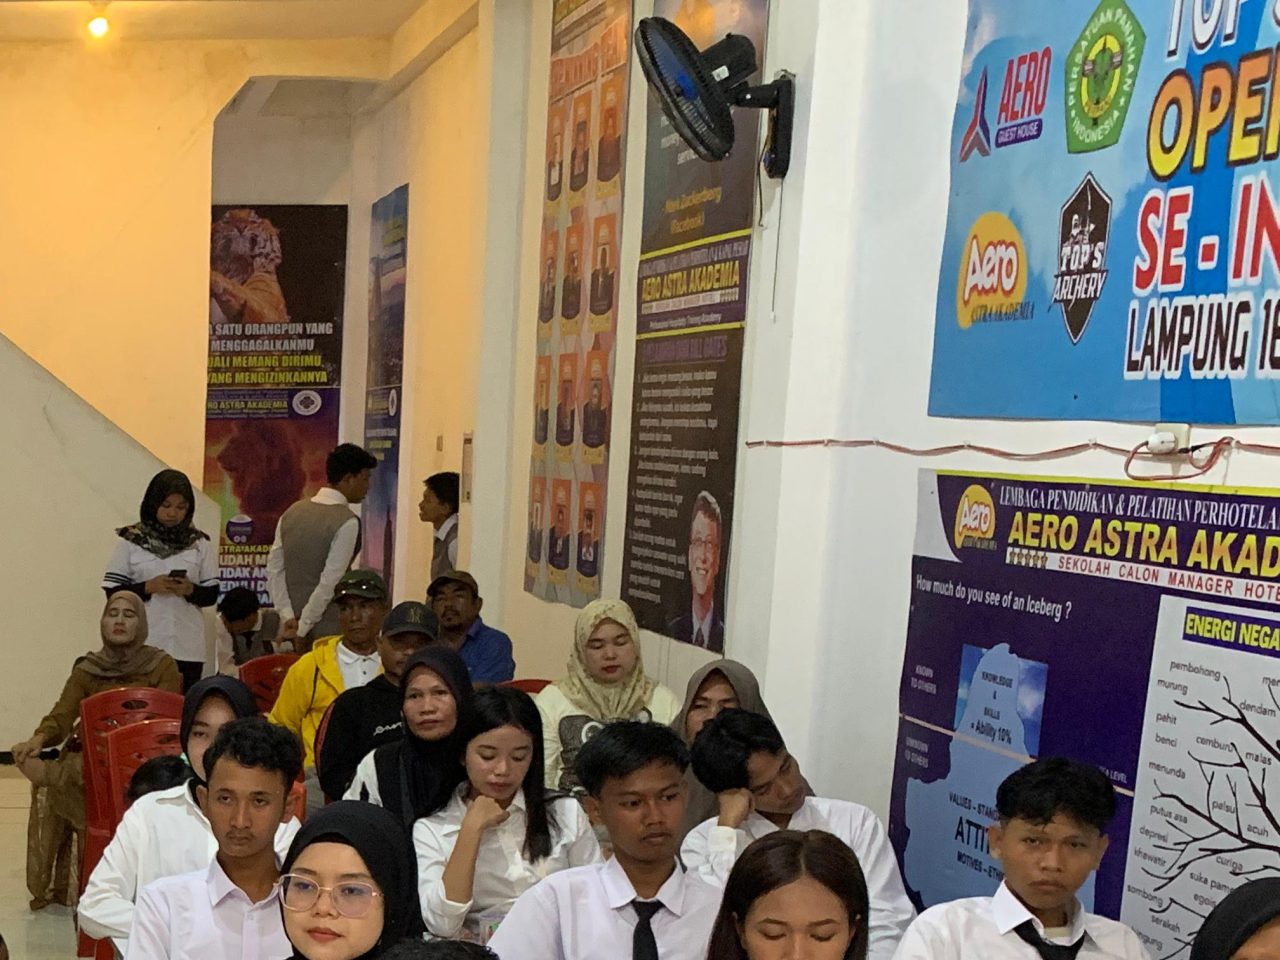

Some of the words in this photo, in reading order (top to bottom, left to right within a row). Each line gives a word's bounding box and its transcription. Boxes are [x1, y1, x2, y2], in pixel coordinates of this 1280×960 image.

[997, 46, 1052, 125] AERO
[1018, 121, 1039, 139] HOUSE
[1072, 110, 1120, 143] INDONESIA
[1133, 188, 1193, 296] SE
[1060, 242, 1105, 272] TOP'S
[661, 271, 687, 298] ASTRA
[689, 260, 740, 293] AKADEMIA
[964, 234, 1020, 308] Aero
[1051, 271, 1107, 306] ARCHERY
[215, 323, 242, 335] SATU
[244, 323, 304, 335] ORANGPUN
[305, 322, 333, 335] YANG
[1124, 297, 1252, 378] LAMPUNG
[232, 355, 278, 367] MEMANG
[220, 401, 245, 410] ASTRA
[247, 400, 288, 410] AKADEMIA
[958, 494, 992, 536] Aero
[999, 485, 1045, 509] LEMBAGA
[1047, 489, 1114, 515] PENDIDIKAN
[1115, 494, 1125, 516] &
[1127, 495, 1191, 523] PELATIHAN
[1192, 500, 1280, 531] PERHOTELA
[1008, 511, 1079, 551] AERO
[1083, 518, 1178, 566] ASTRA
[243, 545, 272, 553] AKAD
[1058, 554, 1111, 576] SEKOLAH
[1119, 565, 1160, 583] CALON
[1168, 571, 1233, 596] MANAGER
[916, 574, 932, 592] How
[933, 578, 953, 597] much
[955, 581, 966, 599] do
[967, 588, 984, 605] you
[985, 590, 1000, 606] see
[1002, 591, 1013, 608] of
[1013, 596, 1025, 611] an
[1027, 595, 1062, 623] Iceberg
[1185, 613, 1237, 642] ENERGI
[982, 671, 1013, 688] KNOWLEDGE
[1170, 661, 1221, 681] pembohong
[1157, 678, 1189, 695] murung
[1239, 700, 1276, 717] dendam
[1155, 712, 1177, 728] pahit
[975, 719, 996, 742] Ability
[998, 726, 1012, 744] 10%
[1155, 733, 1177, 748] benci
[1195, 735, 1233, 753] cemburu
[1245, 750, 1272, 766] malas
[1148, 759, 1186, 780] menunda
[949, 792, 972, 810] VALUES
[1212, 799, 1236, 814] palsu
[1150, 804, 1172, 820] putus
[1173, 812, 1188, 824] asa
[1139, 825, 1168, 843] depresi
[1247, 823, 1269, 838] acuh
[957, 850, 983, 873] MOTIVES
[1134, 846, 1167, 867] khawatir
[1215, 854, 1244, 872] curiga
[1190, 871, 1209, 885] suka
[1127, 884, 1164, 908] sombong
[1151, 914, 1181, 934] serakah
